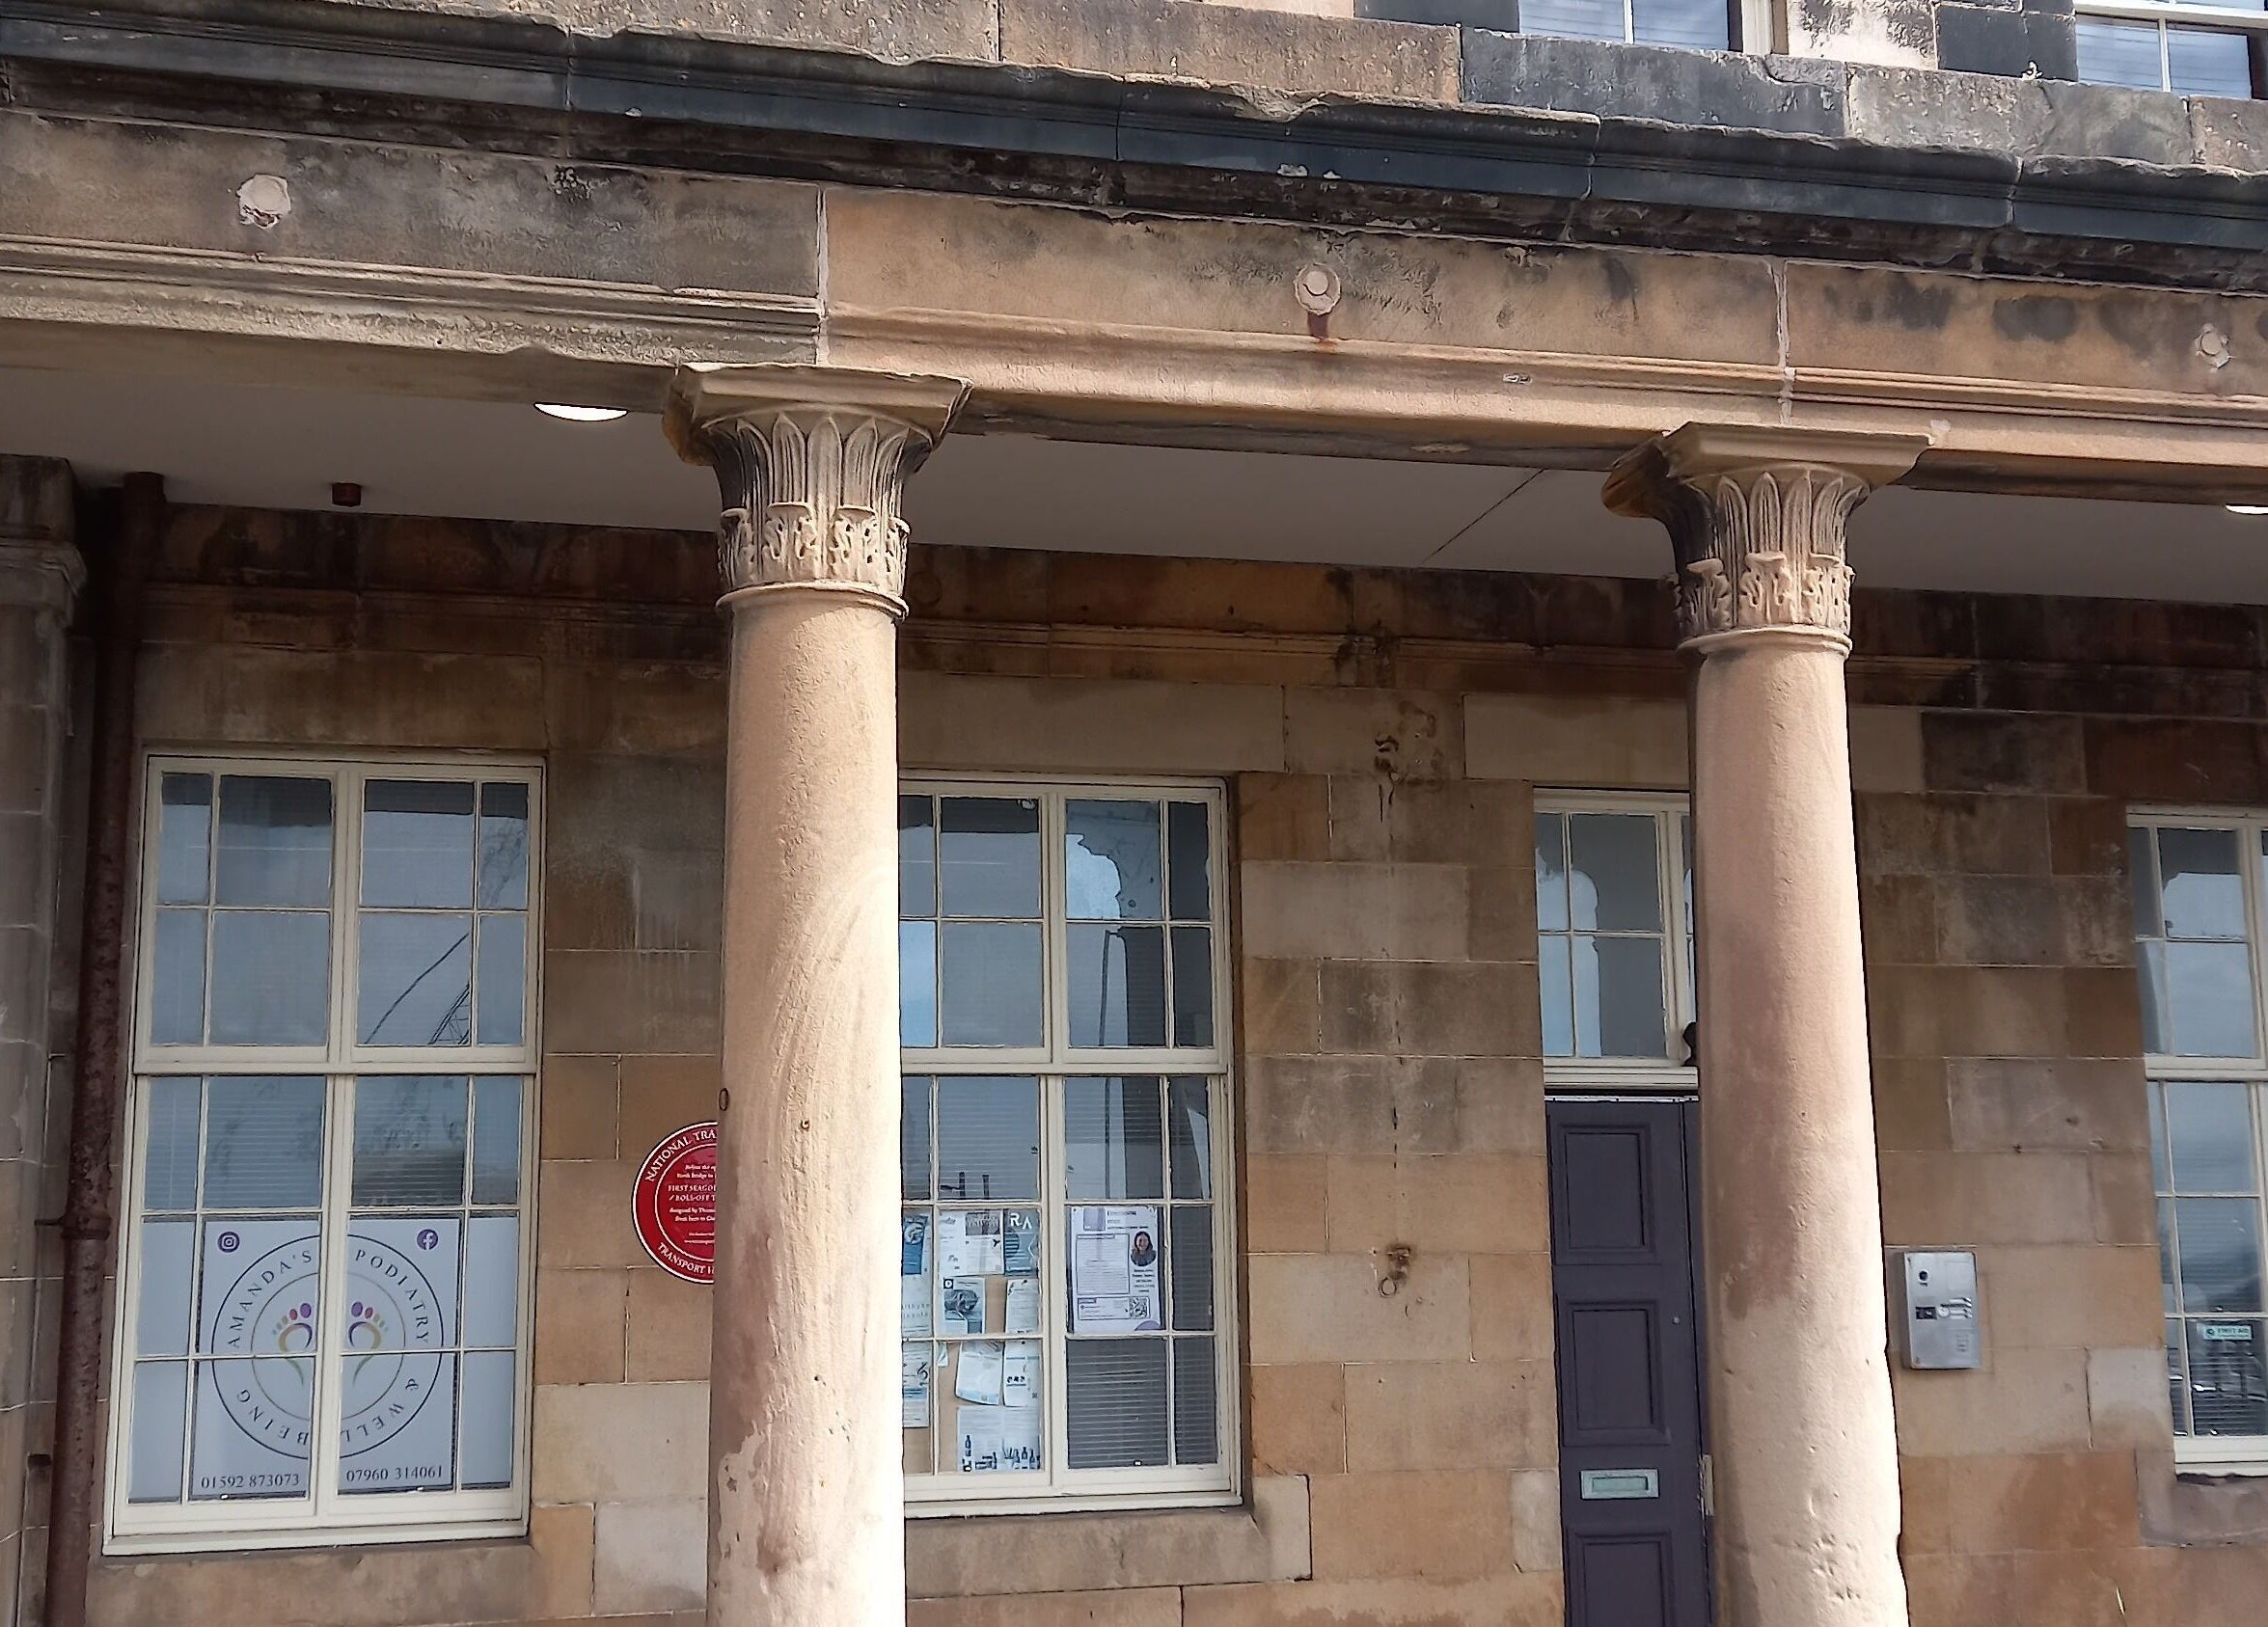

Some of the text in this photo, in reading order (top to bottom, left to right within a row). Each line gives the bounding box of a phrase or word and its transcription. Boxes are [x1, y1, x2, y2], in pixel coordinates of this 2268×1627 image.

[644, 1136, 693, 1182] NATIONAL
[658, 1242, 706, 1274] TRANSPORT
[228, 1249, 429, 1348] AMANDA'S PODIATRY
[201, 1473, 300, 1489] 01592 873073
[345, 1464, 444, 1482] 07960 314061
